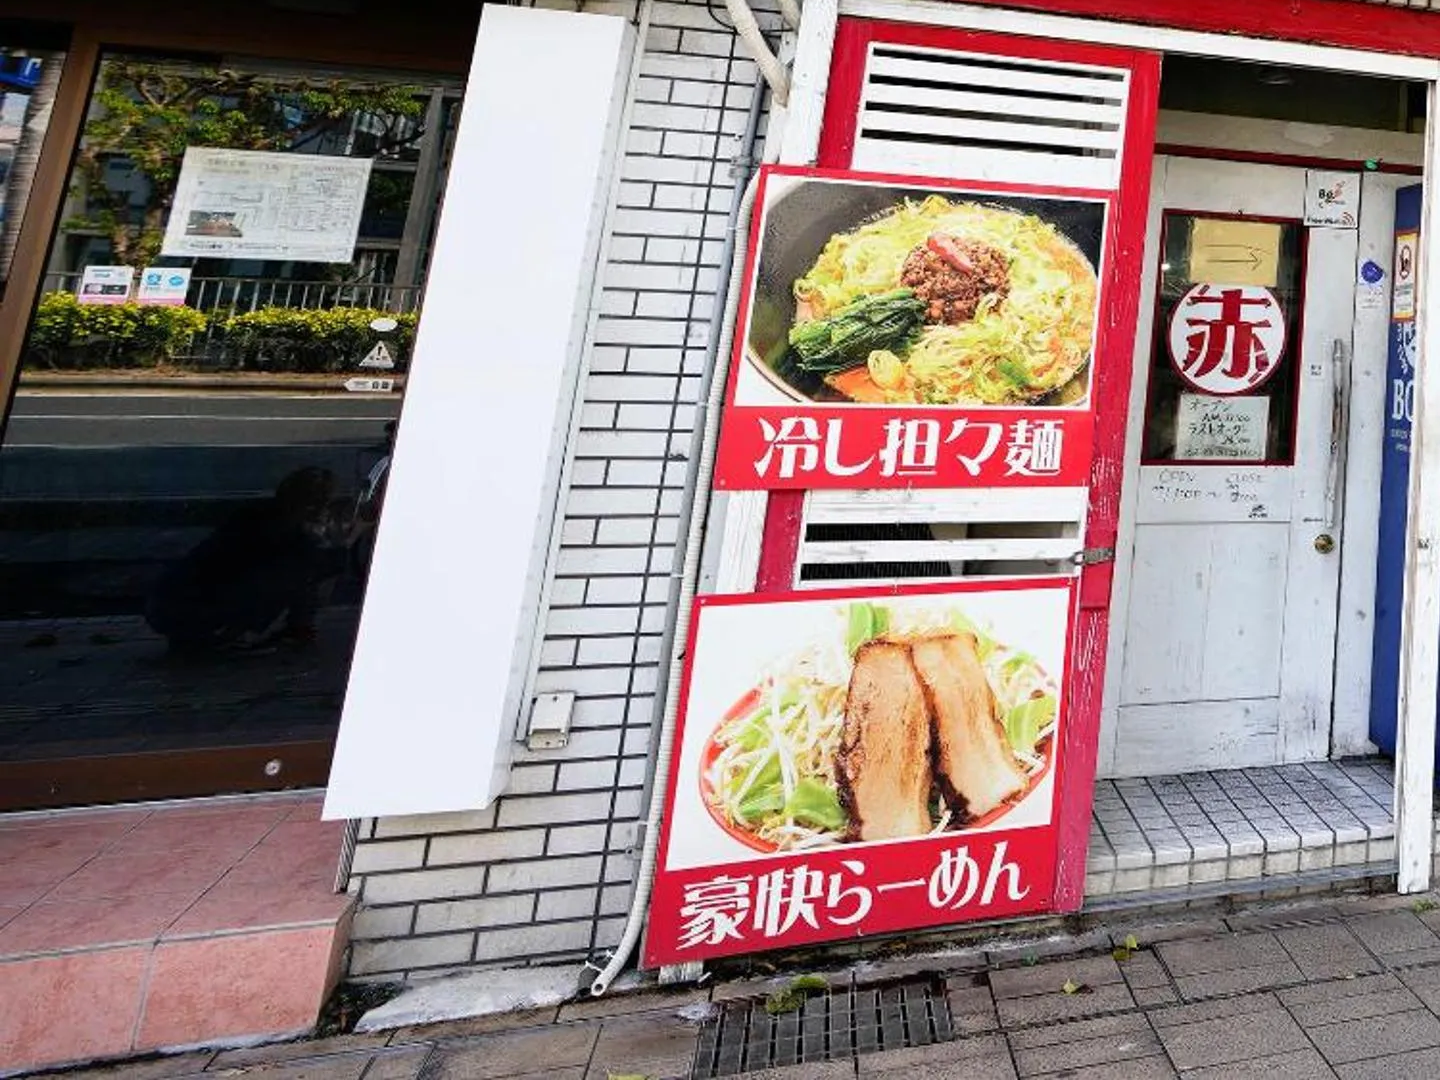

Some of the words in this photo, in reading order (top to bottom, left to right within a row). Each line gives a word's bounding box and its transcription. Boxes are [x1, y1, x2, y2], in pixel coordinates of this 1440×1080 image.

[1183, 288, 1271, 379] 赤
[753, 415, 1064, 478] 冷し担々麺
[676, 840, 1030, 951] 豪快らーめん
